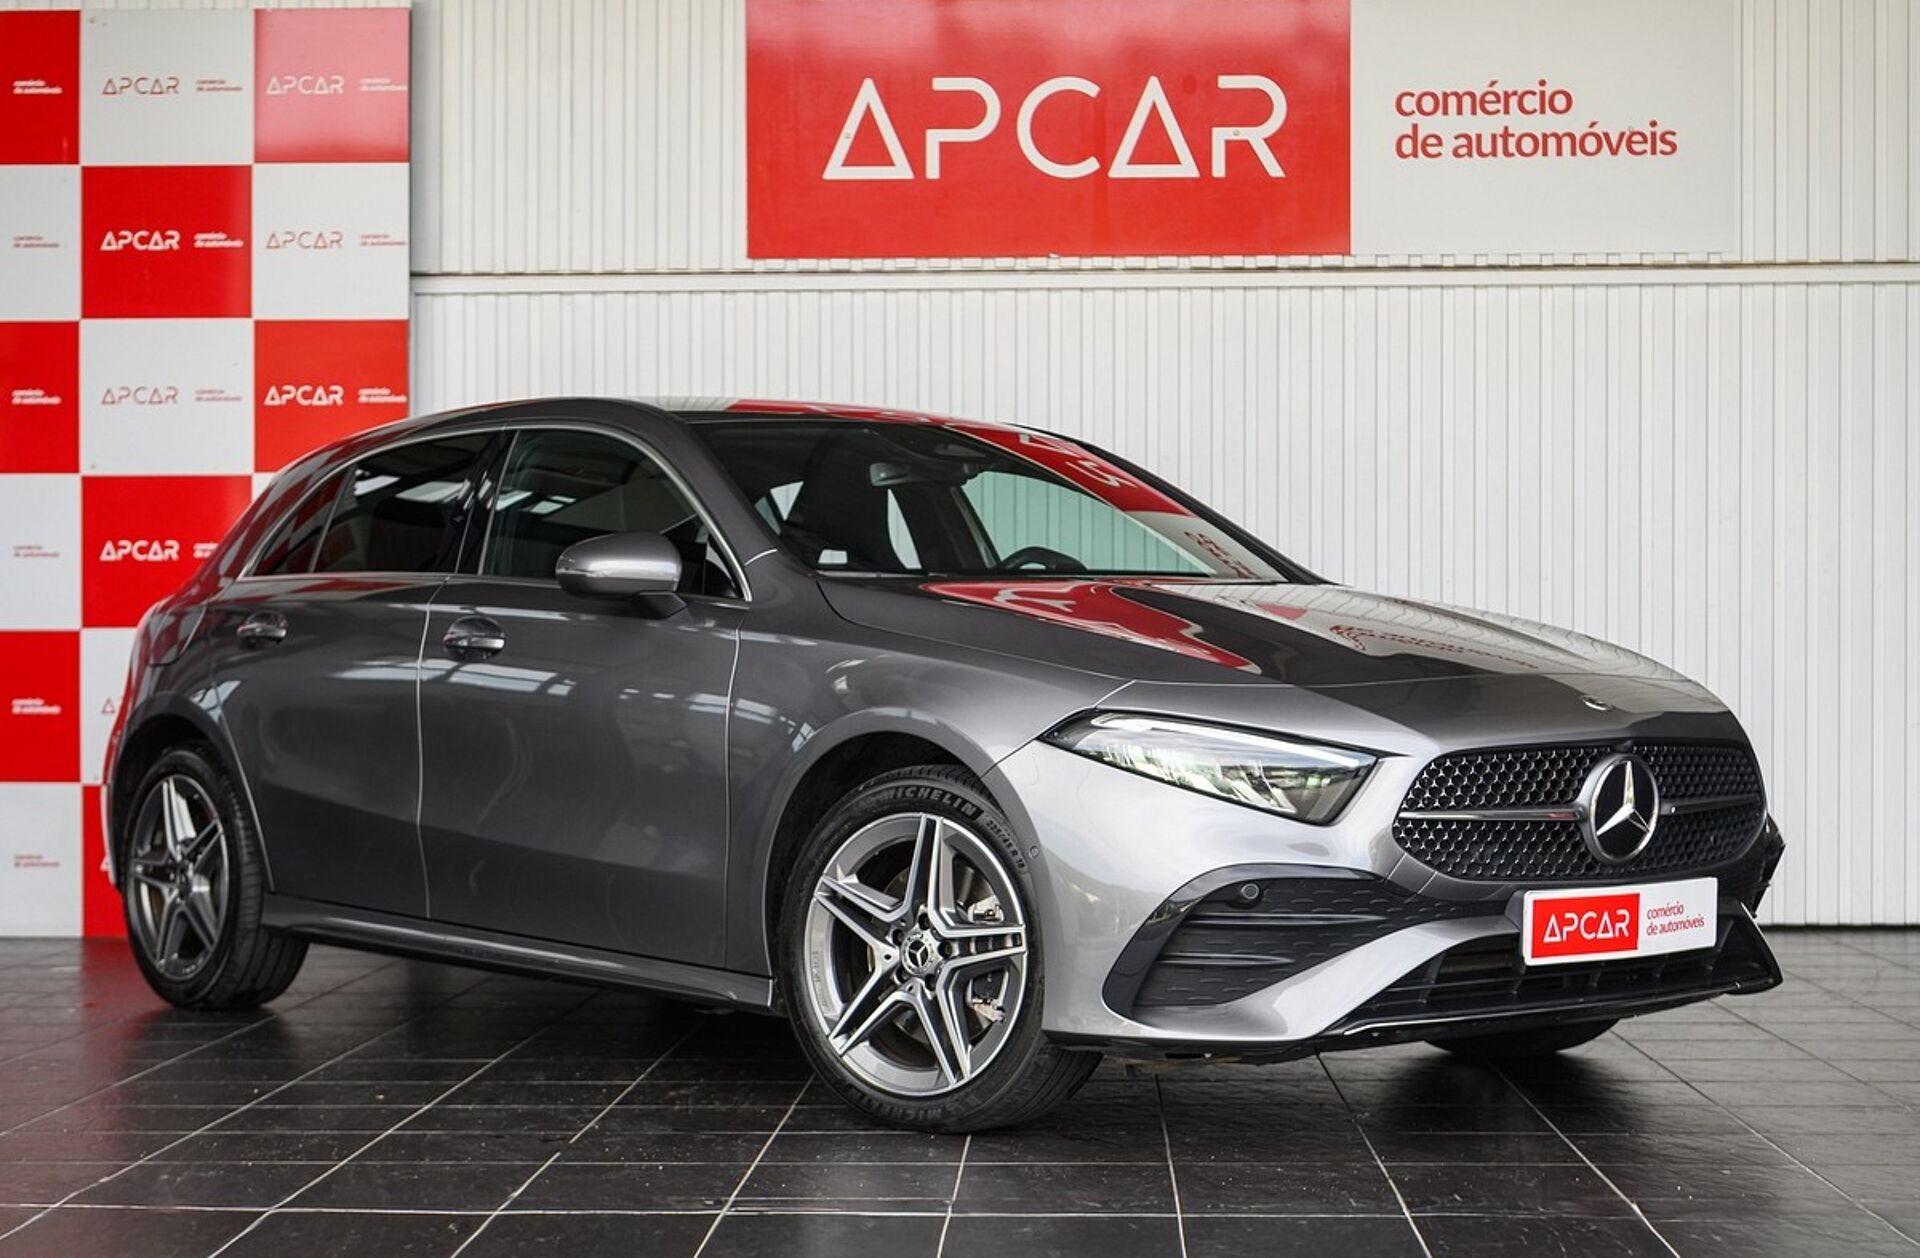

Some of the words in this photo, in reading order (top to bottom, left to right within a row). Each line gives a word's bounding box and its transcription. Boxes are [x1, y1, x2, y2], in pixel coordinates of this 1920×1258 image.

[102, 76, 180, 96] APCAR
[266, 75, 345, 95] APCAR
[1395, 79, 1573, 117] comércio
[823, 75, 1287, 180] APCAR
[1395, 123, 1443, 159] de
[1451, 120, 1678, 159] automóveis
[100, 230, 181, 251] APCAR
[265, 230, 344, 250] APCAR
[101, 386, 178, 406] APCAR
[264, 384, 344, 406] APCAR
[100, 539, 180, 561] APCAR
[1543, 908, 1631, 943] APCAR
[1646, 901, 1685, 929] comércio
[1646, 922, 1658, 935] de
[1658, 914, 1705, 934] automóveis
